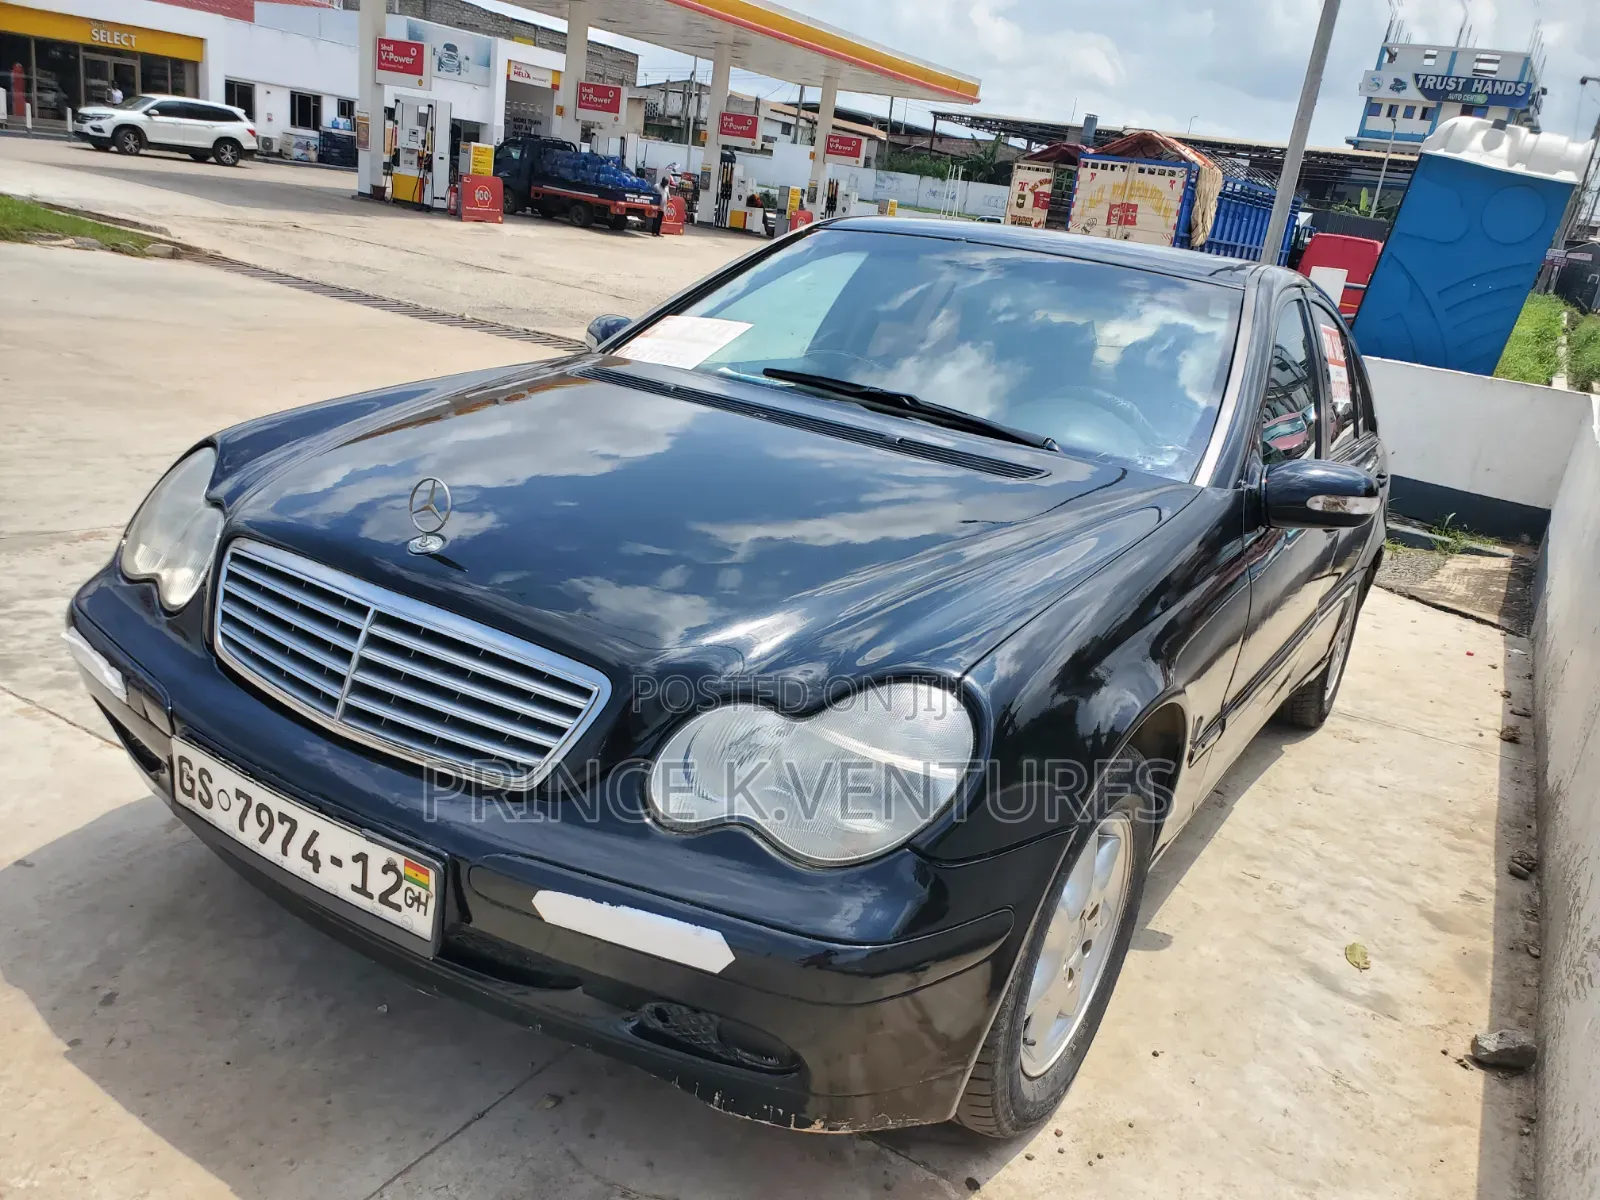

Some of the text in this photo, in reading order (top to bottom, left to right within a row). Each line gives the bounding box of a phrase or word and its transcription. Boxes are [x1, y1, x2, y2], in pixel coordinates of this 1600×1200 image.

[91, 28, 137, 48] SELECT
[380, 43, 394, 52] Shell
[381, 50, 414, 64] V-Power
[513, 69, 531, 80] HELIX
[581, 86, 594, 94] Shell
[1417, 74, 1528, 97] TRUST HANDS
[581, 93, 612, 105] V-Power
[1447, 92, 1463, 101] AUTO
[723, 121, 750, 131] V-Power
[829, 142, 854, 152] V-Power
[177, 754, 404, 914] GS 7974-12
[403, 886, 430, 917] GH
